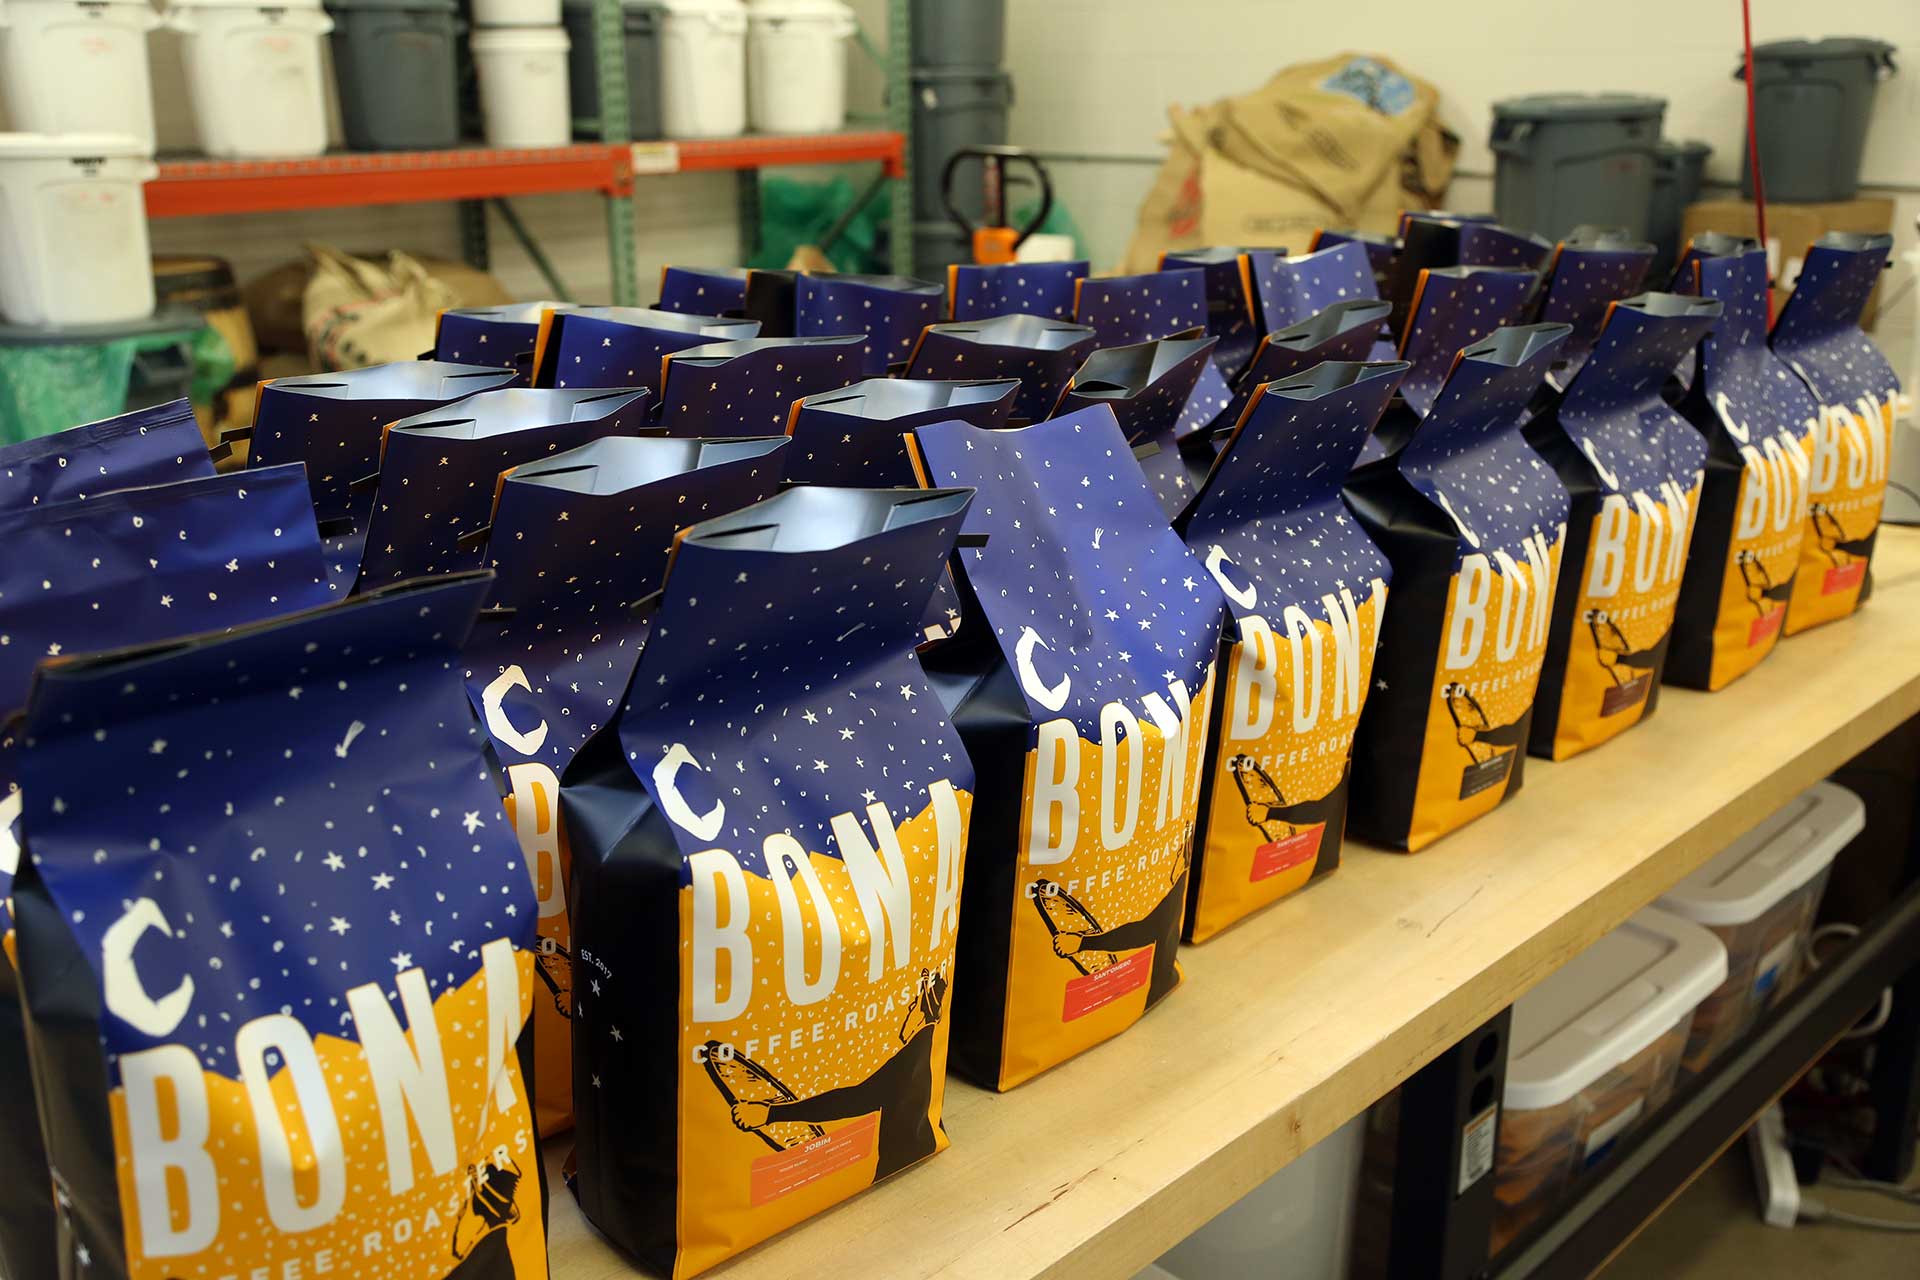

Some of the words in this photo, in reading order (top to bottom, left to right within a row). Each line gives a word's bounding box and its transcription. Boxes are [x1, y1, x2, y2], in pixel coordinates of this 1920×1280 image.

[1225, 746, 1310, 772] COFFEE
[689, 778, 962, 1024] BONA
[1025, 865, 1126, 900] COFFEE
[595, 958, 613, 979] 2017
[692, 1021, 825, 1064] COFFEE
[119, 936, 521, 1259] BONA
[804, 1136, 833, 1153] JOBIM
[363, 1130, 532, 1228] ROASTERS
